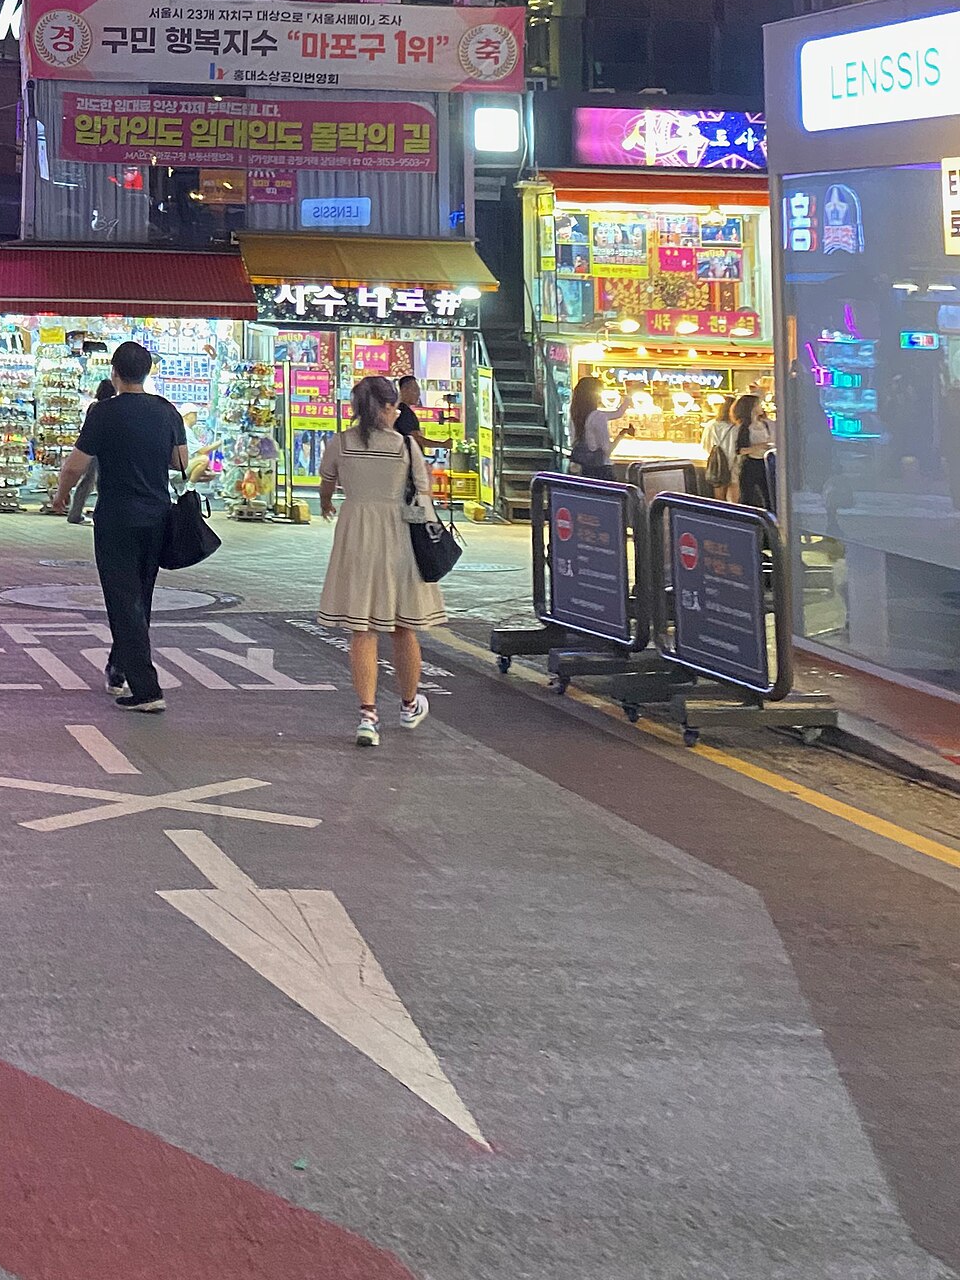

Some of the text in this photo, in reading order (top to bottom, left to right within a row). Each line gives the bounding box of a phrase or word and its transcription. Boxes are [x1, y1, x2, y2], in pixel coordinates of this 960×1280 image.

[149, 7, 183, 19] 서울시
[187, 8, 215, 20] 23개
[218, 9, 253, 22] 자치구
[256, 10, 303, 23] 대상으로
[378, 13, 402, 26] 조사
[50, 25, 75, 52] 경
[101, 26, 157, 54] 구민
[165, 26, 278, 57] 행복지수
[474, 38, 502, 66] 축
[233, 70, 339, 85] 홍대소상공인번영회
[830, 47, 941, 100] LENSSIS
[76, 98, 112, 113] 과도한
[114, 99, 151, 113] 임대료
[153, 100, 178, 113] 인상
[178, 101, 205, 114] 자제
[74, 114, 431, 154] 임차인도 임대인도 몰락의 길
